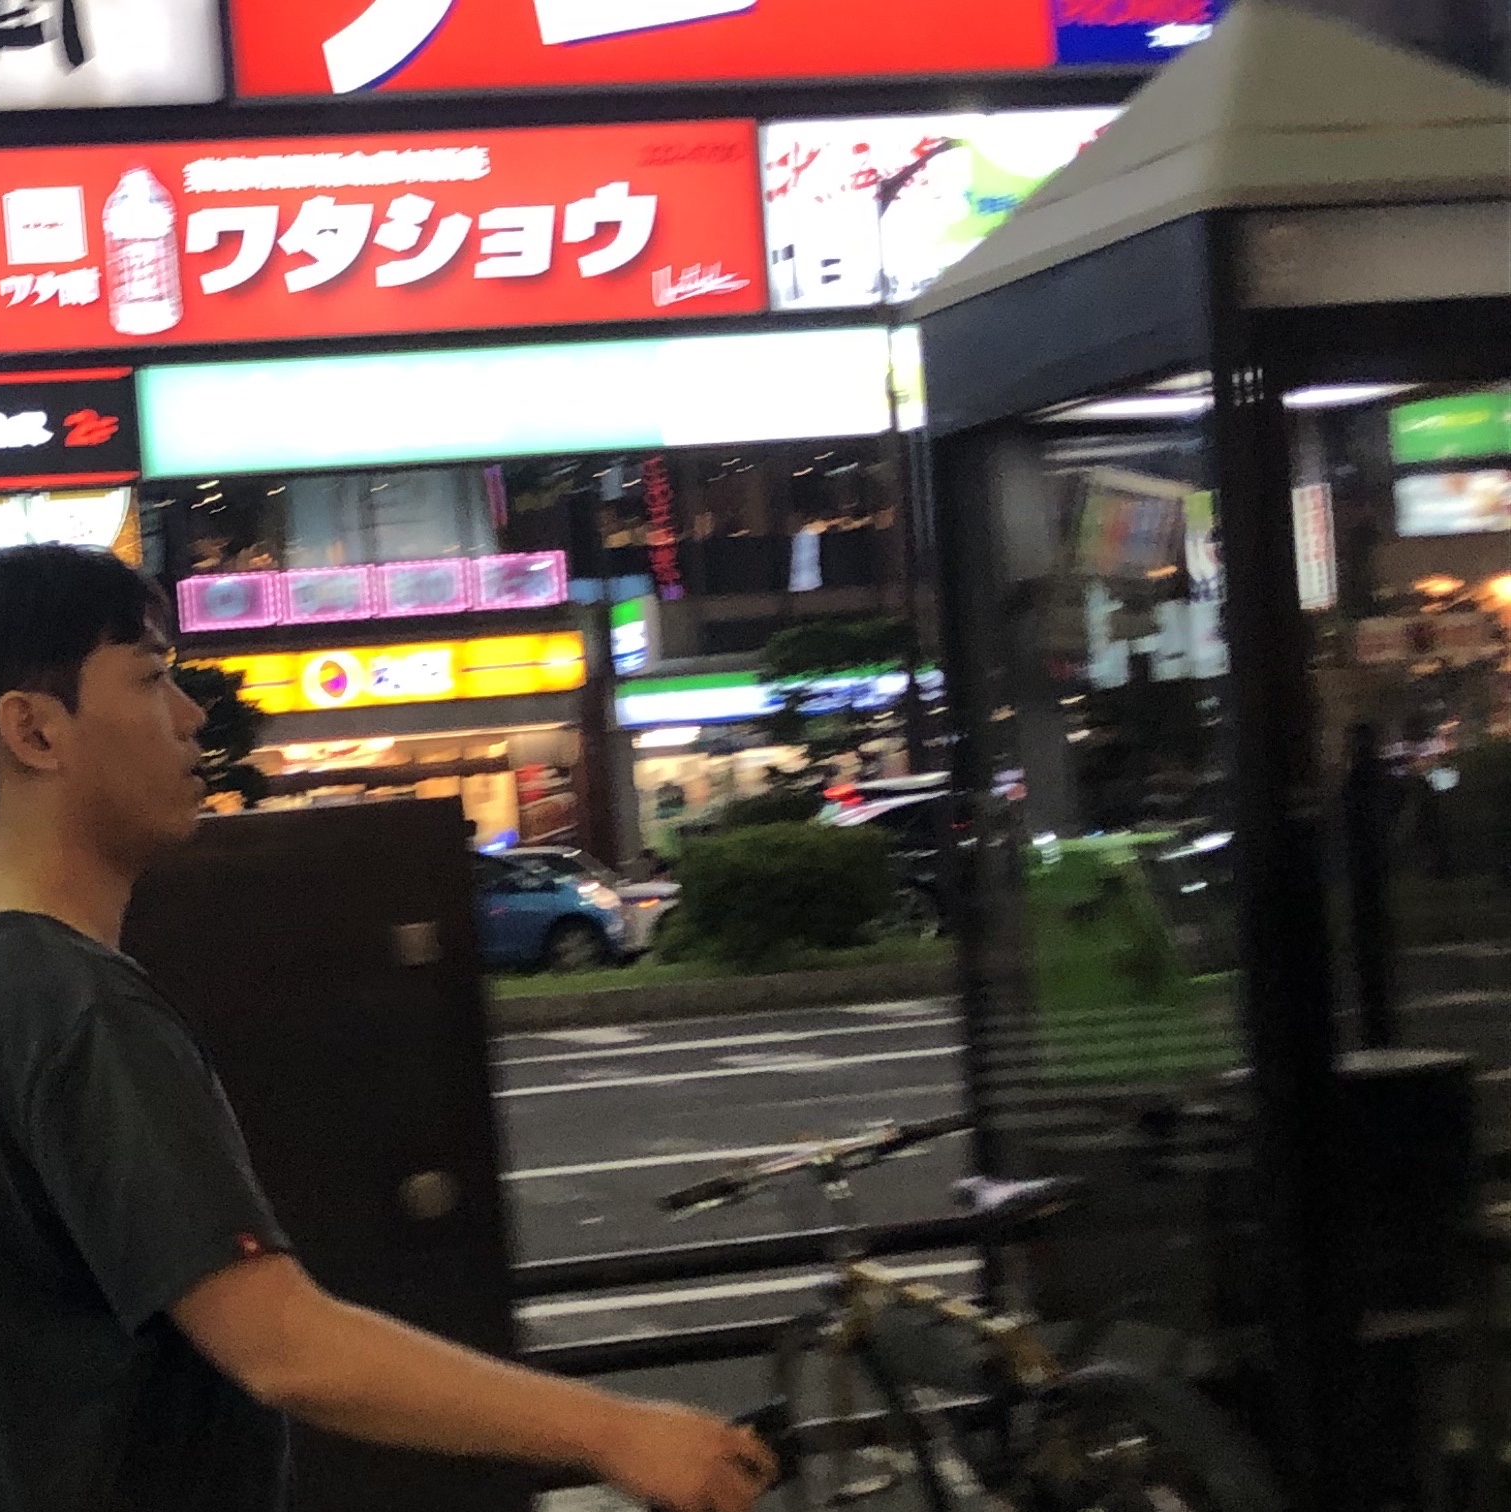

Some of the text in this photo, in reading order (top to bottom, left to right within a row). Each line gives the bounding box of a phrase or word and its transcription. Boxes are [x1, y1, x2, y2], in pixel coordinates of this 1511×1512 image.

[185, 181, 658, 295] ワタショウ
